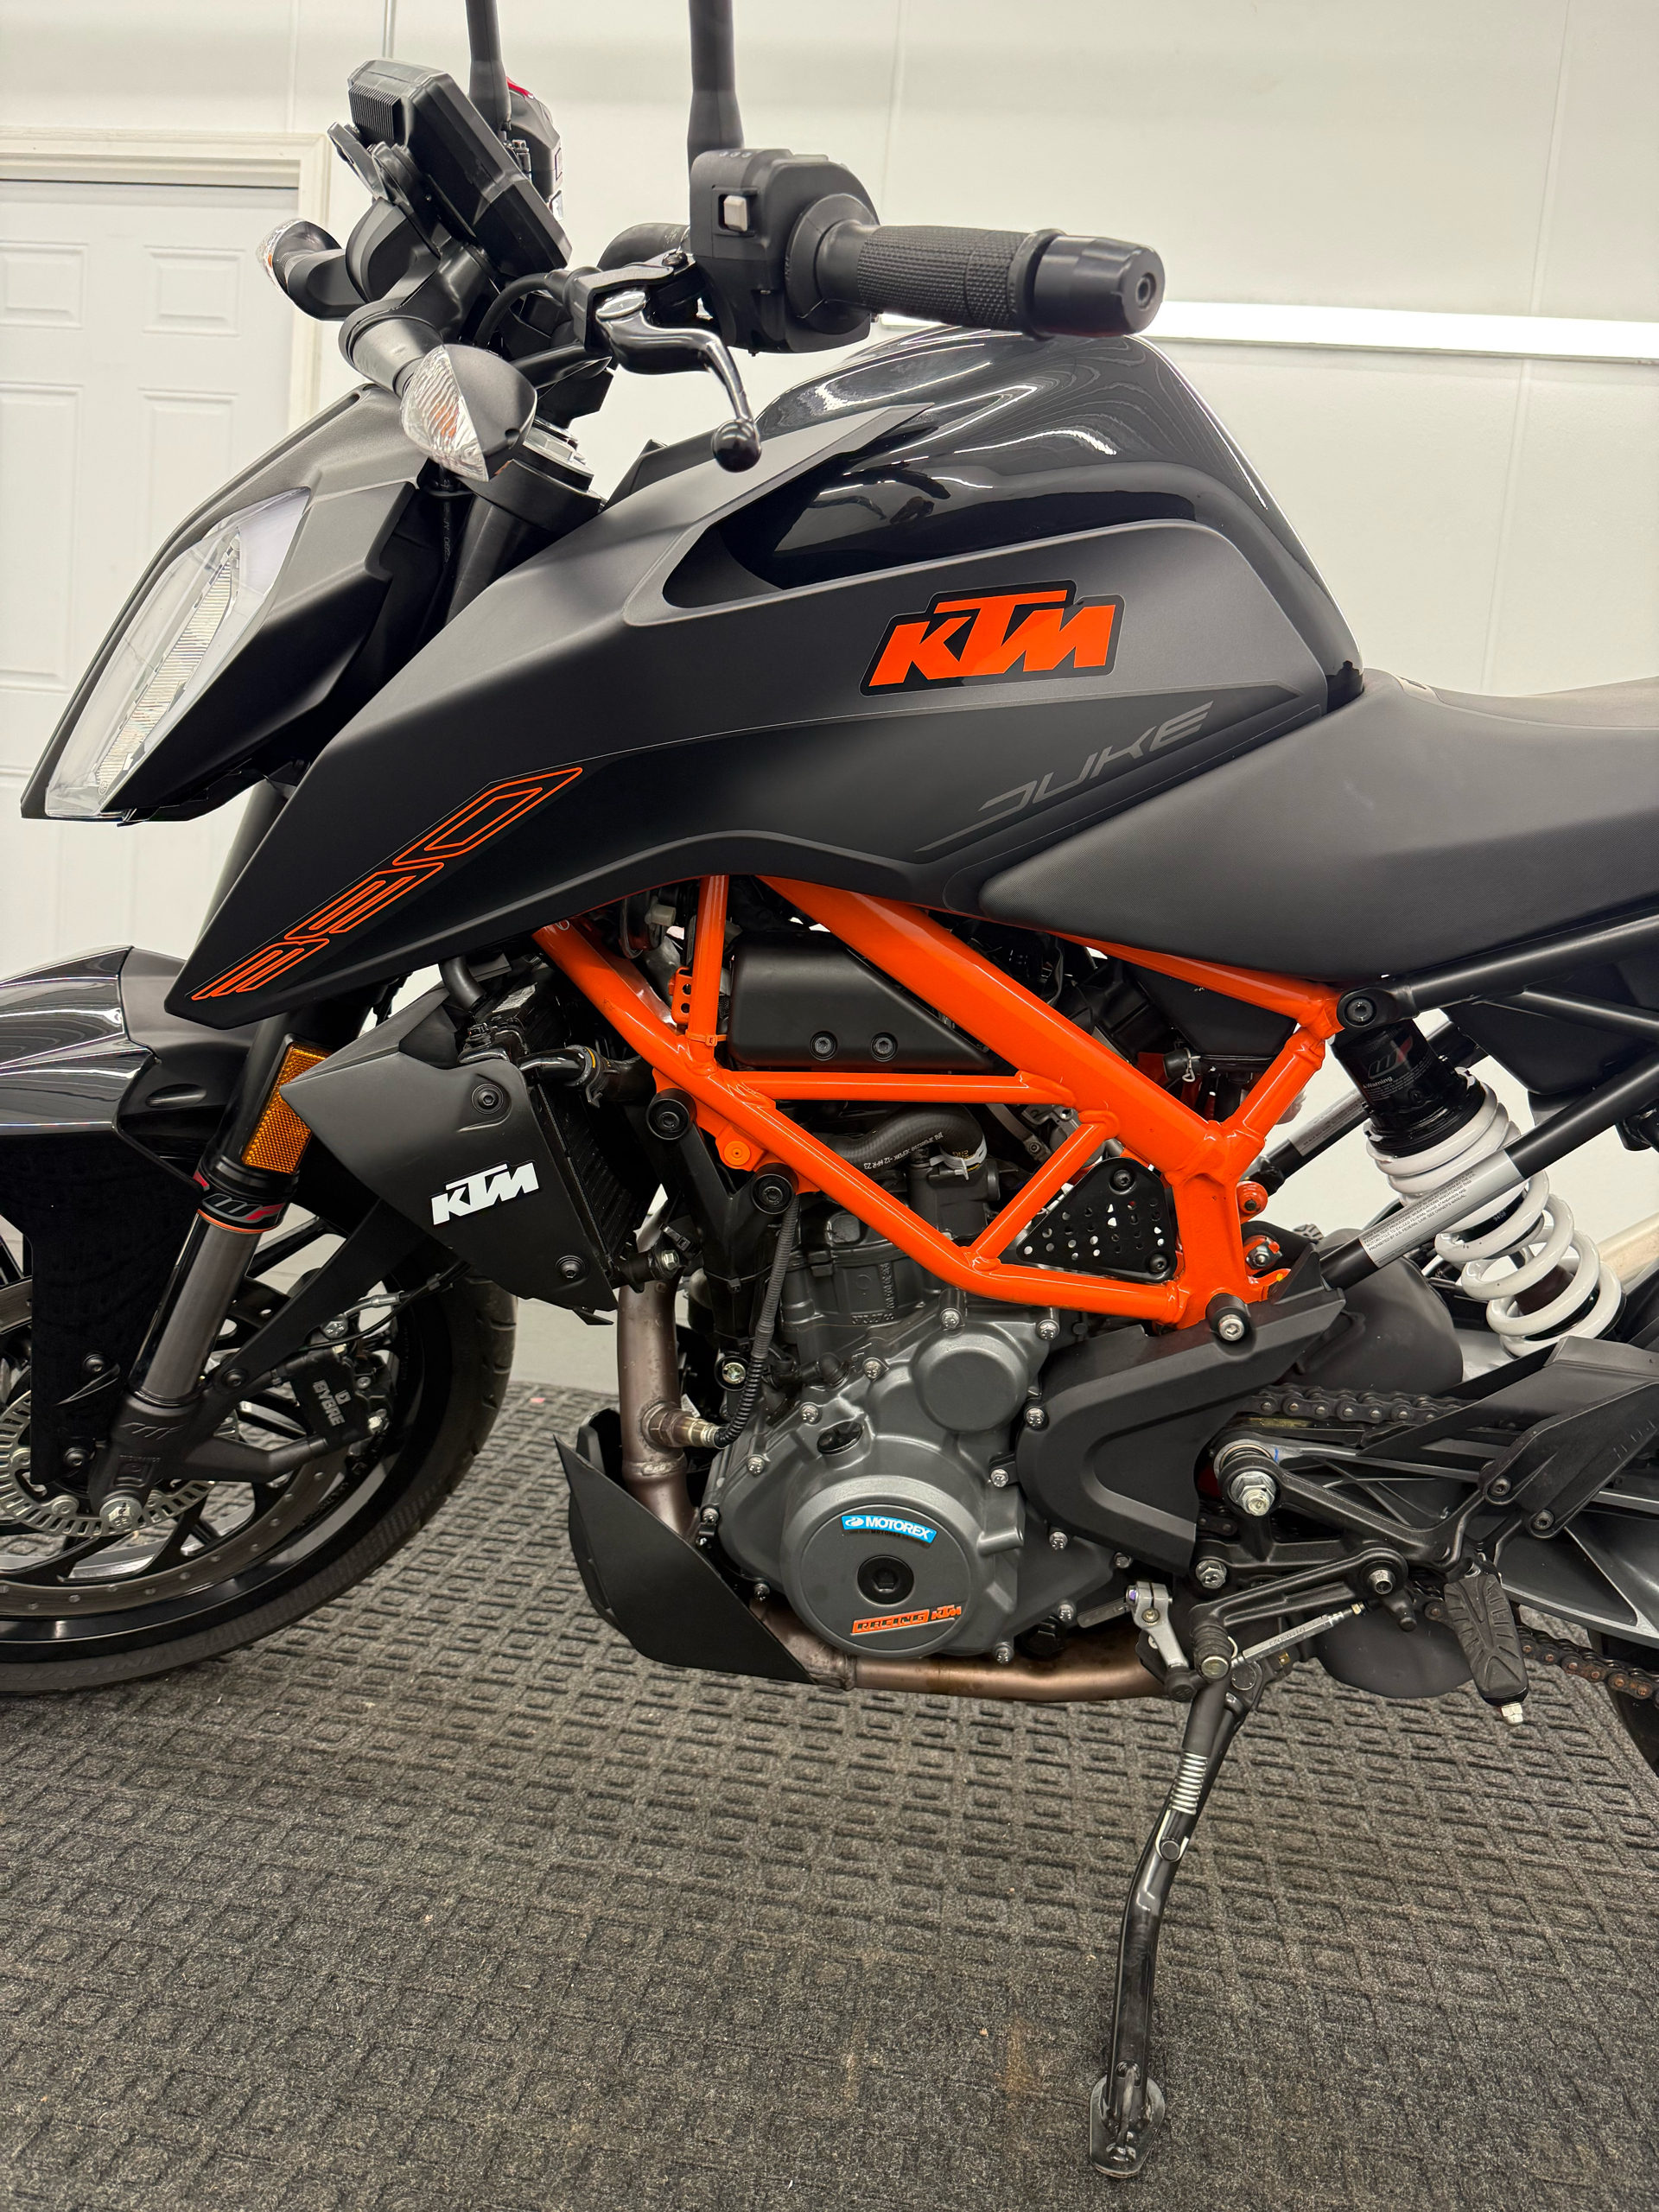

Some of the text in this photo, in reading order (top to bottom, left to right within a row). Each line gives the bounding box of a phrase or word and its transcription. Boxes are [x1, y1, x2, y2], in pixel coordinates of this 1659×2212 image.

[868, 589, 1116, 687] KTM
[913, 700, 1214, 853] DUKE
[191, 766, 583, 1001] 390
[1366, 1077, 1393, 1089] Warning
[431, 1162, 539, 1225] KTM
[312, 1380, 346, 1427] BYBRE
[866, 1516, 931, 1540] MOTOREX
[857, 1605, 962, 1630] RACING KTM
